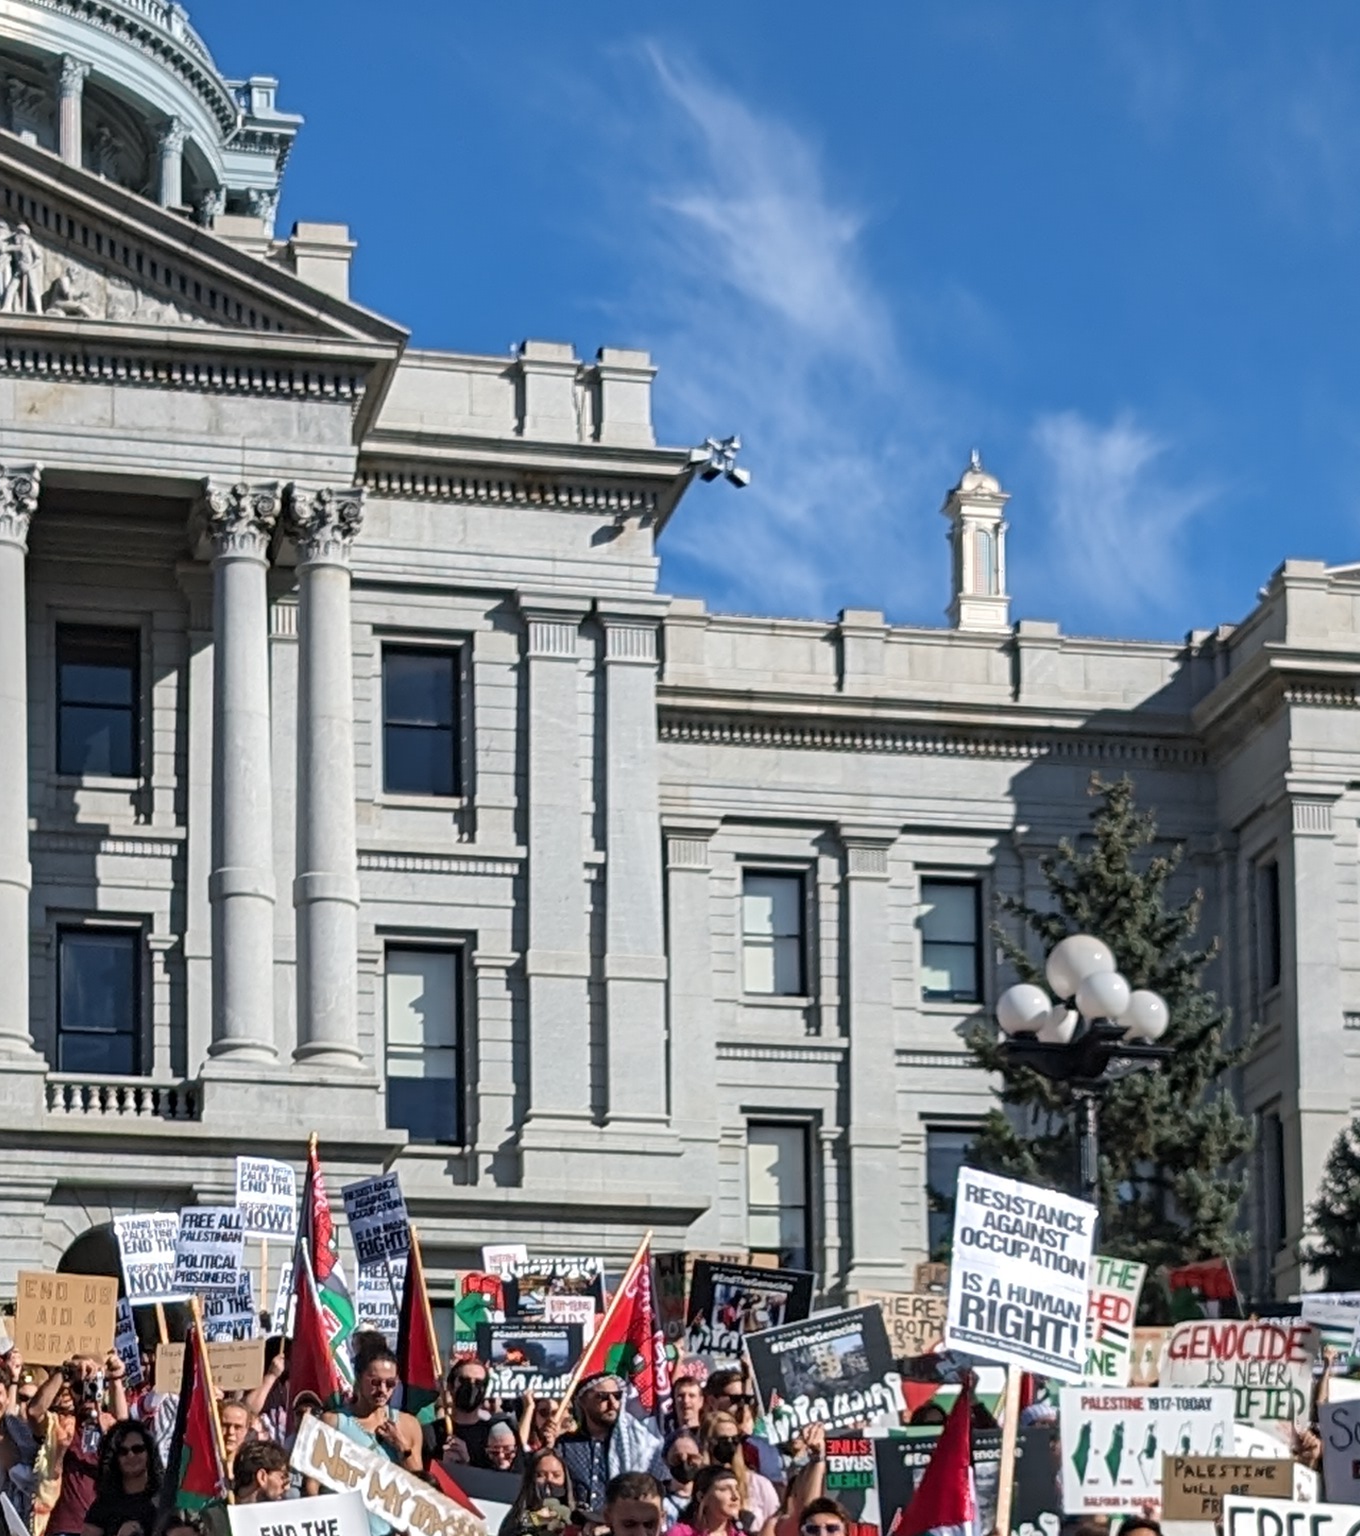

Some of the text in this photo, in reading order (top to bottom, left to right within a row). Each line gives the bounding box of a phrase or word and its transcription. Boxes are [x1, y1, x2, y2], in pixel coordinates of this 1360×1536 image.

[240, 1181, 293, 1196] END THE
[964, 1184, 1087, 1236] RESISTANCE
[182, 1214, 242, 1229] FREE ALL
[983, 1211, 1069, 1251] AGAINST
[124, 1240, 152, 1254] END
[179, 1231, 242, 1243] PALESTINIAN
[177, 1254, 237, 1269] POLITICAL
[961, 1227, 1086, 1280] OCCUPATION
[174, 1271, 236, 1284] PRISONERS
[1097, 1259, 1139, 1291] THE
[24, 1280, 112, 1305] END US
[962, 1271, 982, 1292] IS
[987, 1279, 1002, 1298] A
[1008, 1283, 1081, 1322] HUMAN
[205, 1299, 252, 1316] ND THE
[36, 1308, 96, 1328] AID 4
[959, 1292, 1079, 1359] RIGHT!
[24, 1333, 101, 1356] ISRAEL
[1168, 1324, 1312, 1363] GENOCIDE
[1206, 1362, 1286, 1386] IS NEVER
[1081, 1396, 1144, 1410] PALESTINE
[1174, 1459, 1276, 1478] PALESTINE
[1183, 1483, 1217, 1495] WILL
